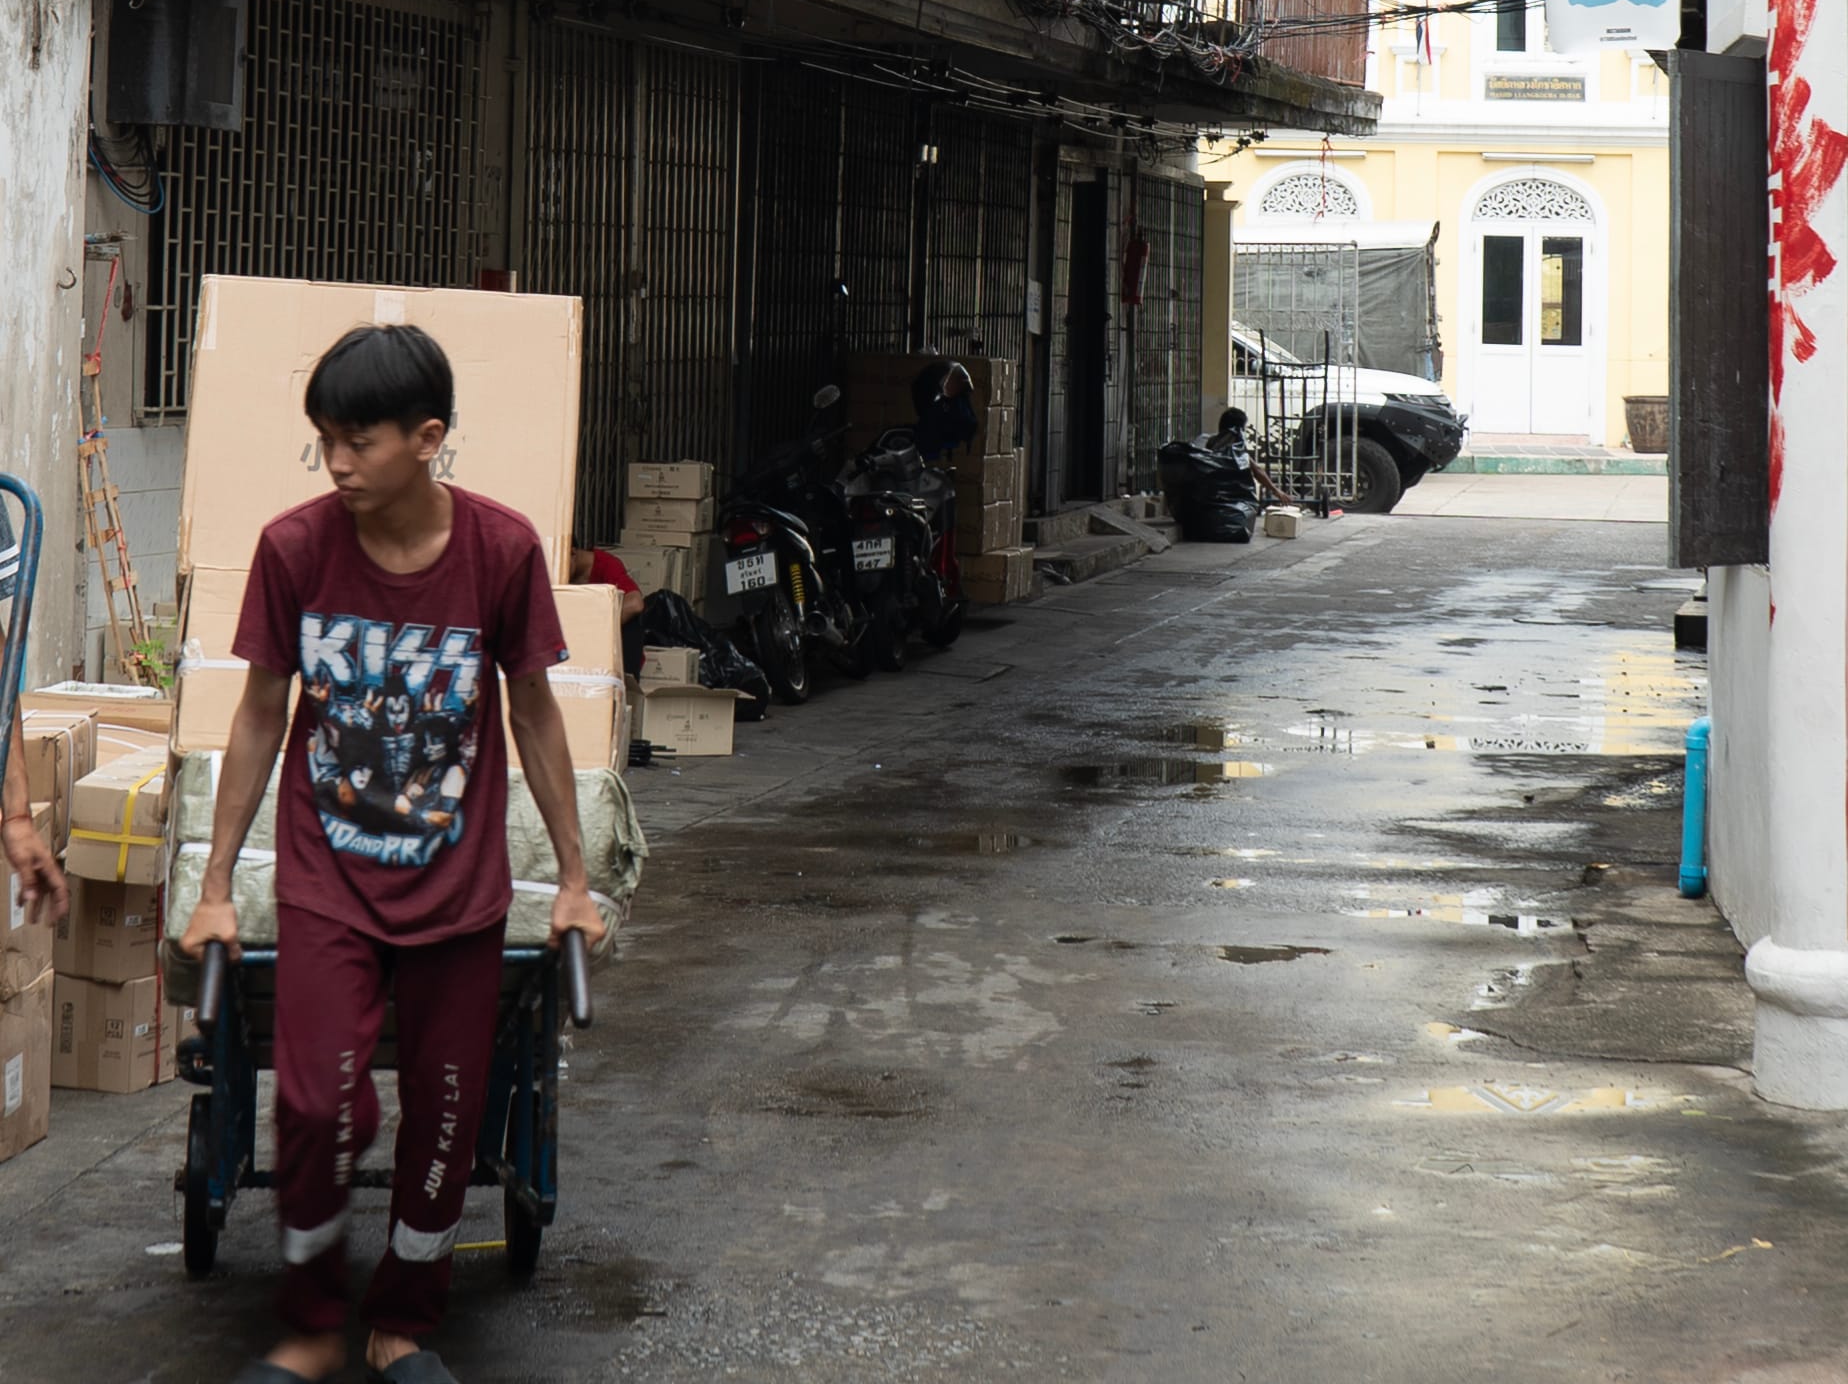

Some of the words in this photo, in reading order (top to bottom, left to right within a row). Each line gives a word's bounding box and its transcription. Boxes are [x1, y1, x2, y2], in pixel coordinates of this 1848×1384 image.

[741, 576, 766, 591] 160
[299, 611, 482, 698] KISS
[443, 1063, 460, 1102] LAI
[437, 1111, 458, 1152] KAI
[423, 1159, 447, 1200] JUN
